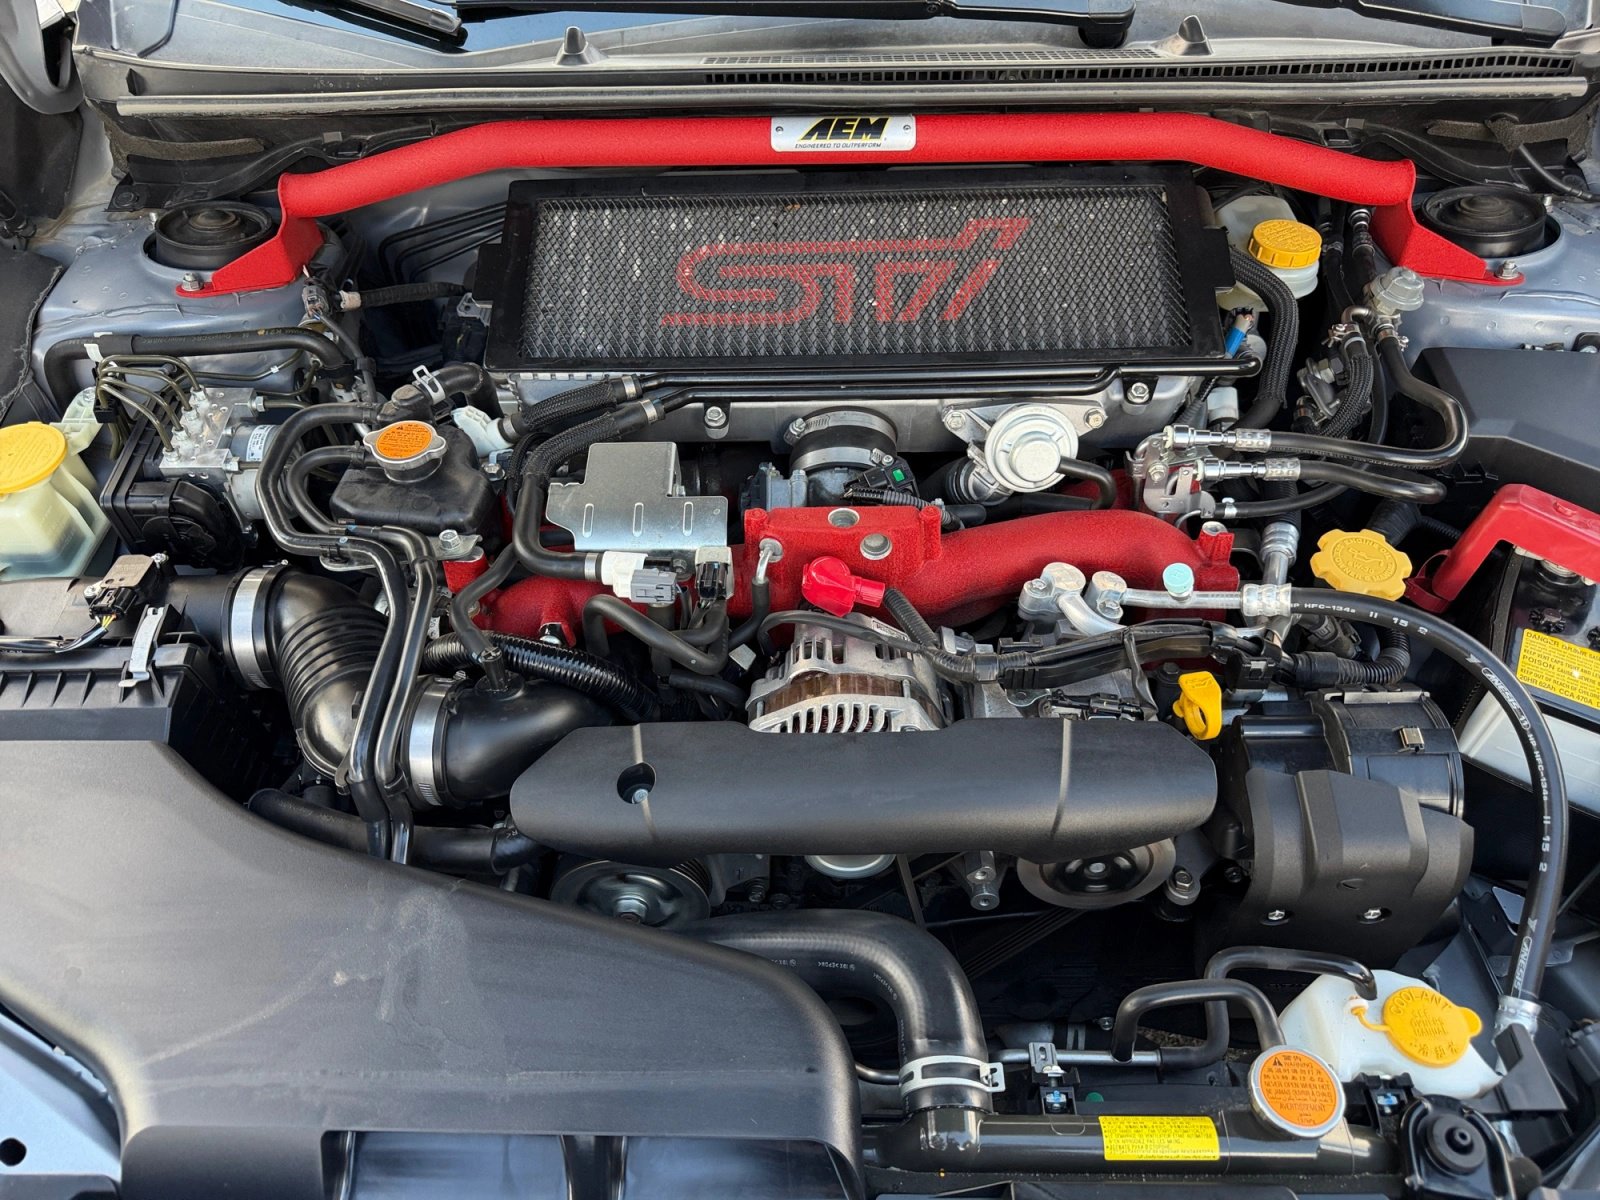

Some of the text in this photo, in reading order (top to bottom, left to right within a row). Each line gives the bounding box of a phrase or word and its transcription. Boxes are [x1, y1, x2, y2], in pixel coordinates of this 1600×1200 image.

[800, 116, 890, 140] AEM
[1526, 632, 1560, 647] DANGER
[1522, 655, 1555, 671] POISON
[1523, 648, 1537, 656] KEEP
[1537, 653, 1550, 661] VENT
[1550, 658, 1564, 667] CAPS
[1520, 667, 1533, 676] KEEP
[1533, 672, 1545, 680] OUT
[1519, 673, 1538, 686] 20HR
[1558, 688, 1575, 699] CCA
[1575, 694, 1593, 706] 470A
[1389, 990, 1453, 1016] COOLANT
